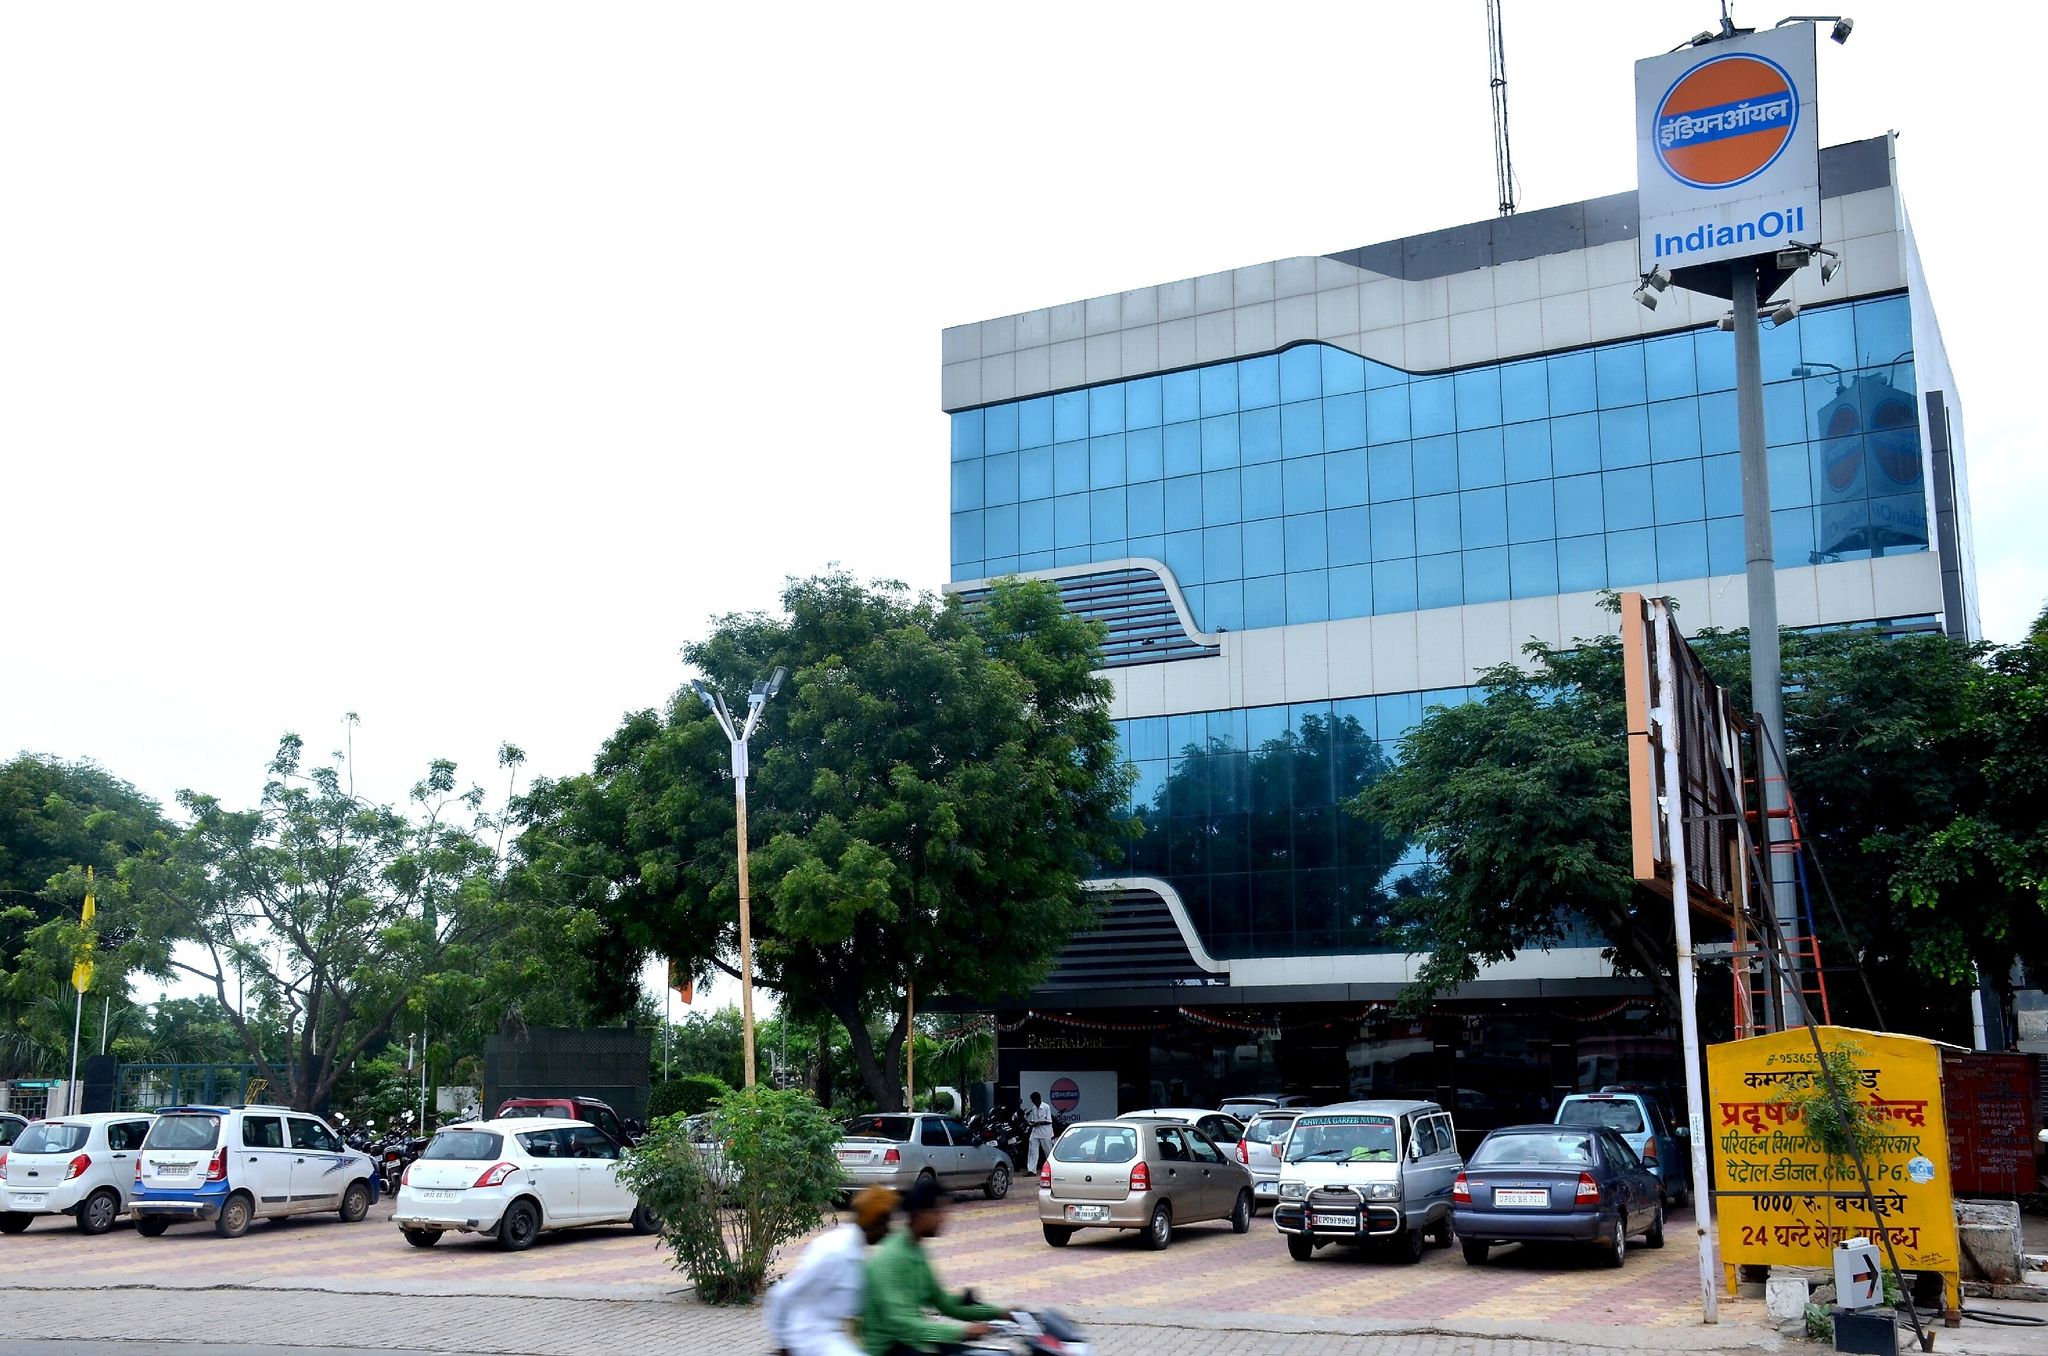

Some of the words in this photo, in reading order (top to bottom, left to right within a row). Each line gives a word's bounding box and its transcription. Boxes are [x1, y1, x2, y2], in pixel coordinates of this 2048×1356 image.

[1660, 98, 1790, 147] इंडियनऑयल
[1655, 206, 1804, 257] IndianOil
[1721, 1129, 1771, 1155] परिवहन
[1741, 1225, 1768, 1247] 24
